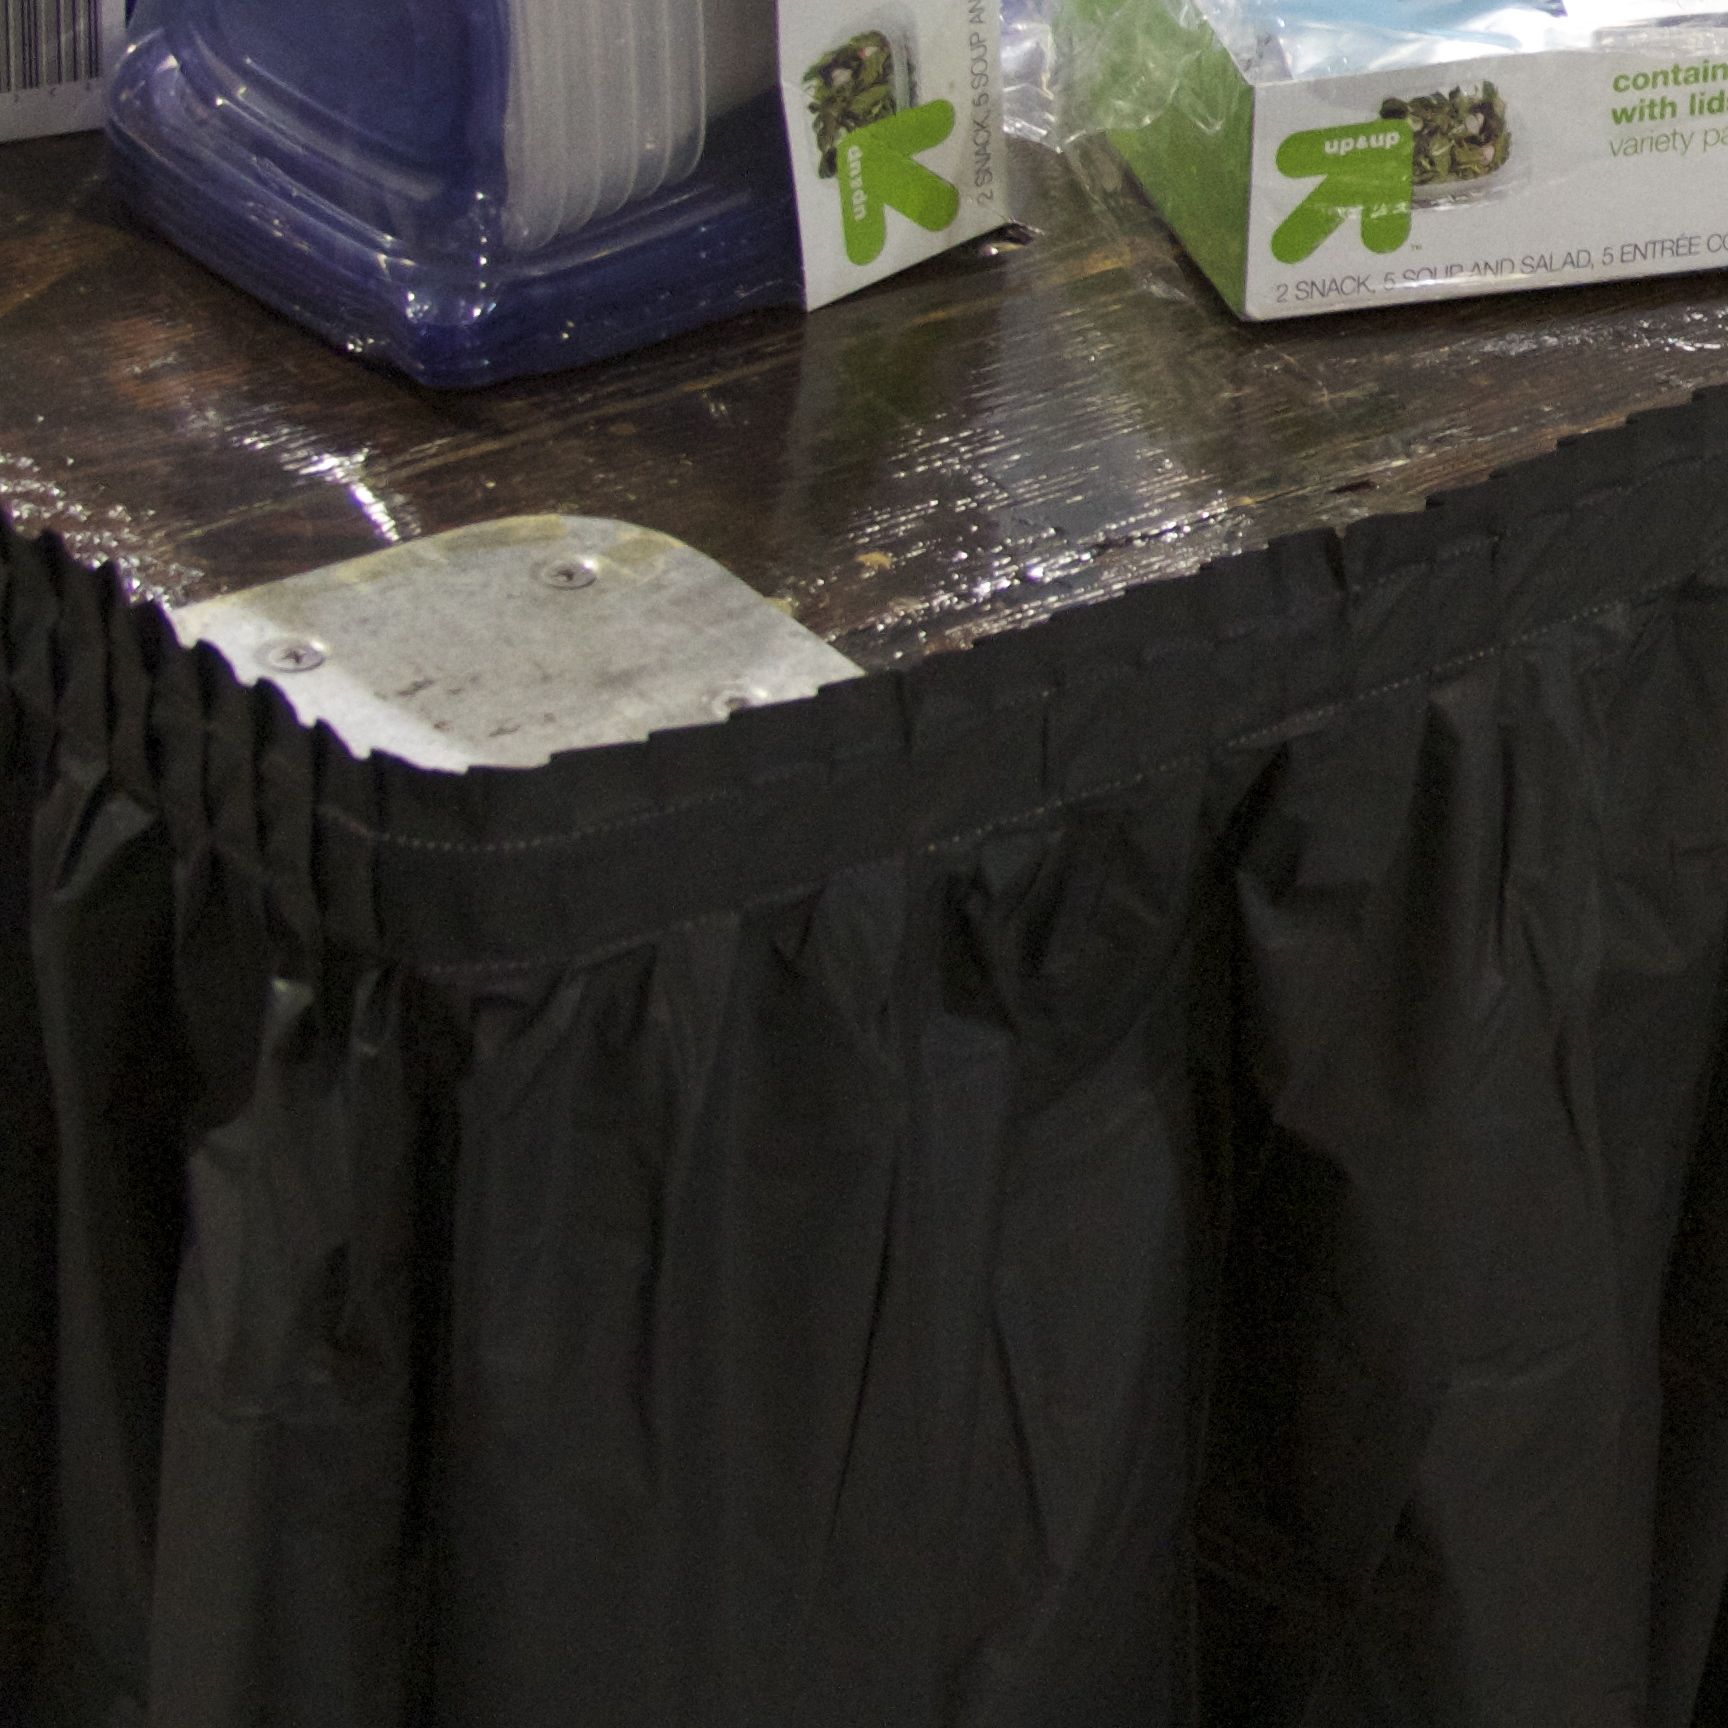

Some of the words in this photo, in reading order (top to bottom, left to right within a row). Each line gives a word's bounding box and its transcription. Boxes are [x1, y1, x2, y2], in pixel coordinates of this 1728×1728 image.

[970, 32, 990, 90] SOUP
[972, 92, 990, 109] 5
[1611, 96, 1678, 126] with
[973, 111, 993, 188] SNACK,
[1323, 130, 1400, 156] up&up
[1608, 125, 1695, 158] variety
[846, 144, 868, 221] up&up
[977, 189, 993, 206] 2
[1276, 283, 1290, 303] 2
[1295, 274, 1376, 301] SNACK,
[1383, 271, 1397, 290] 5
[1470, 257, 1516, 277] AND
[1602, 243, 1614, 265] 5
[1619, 231, 1701, 264] ENTRÉE
